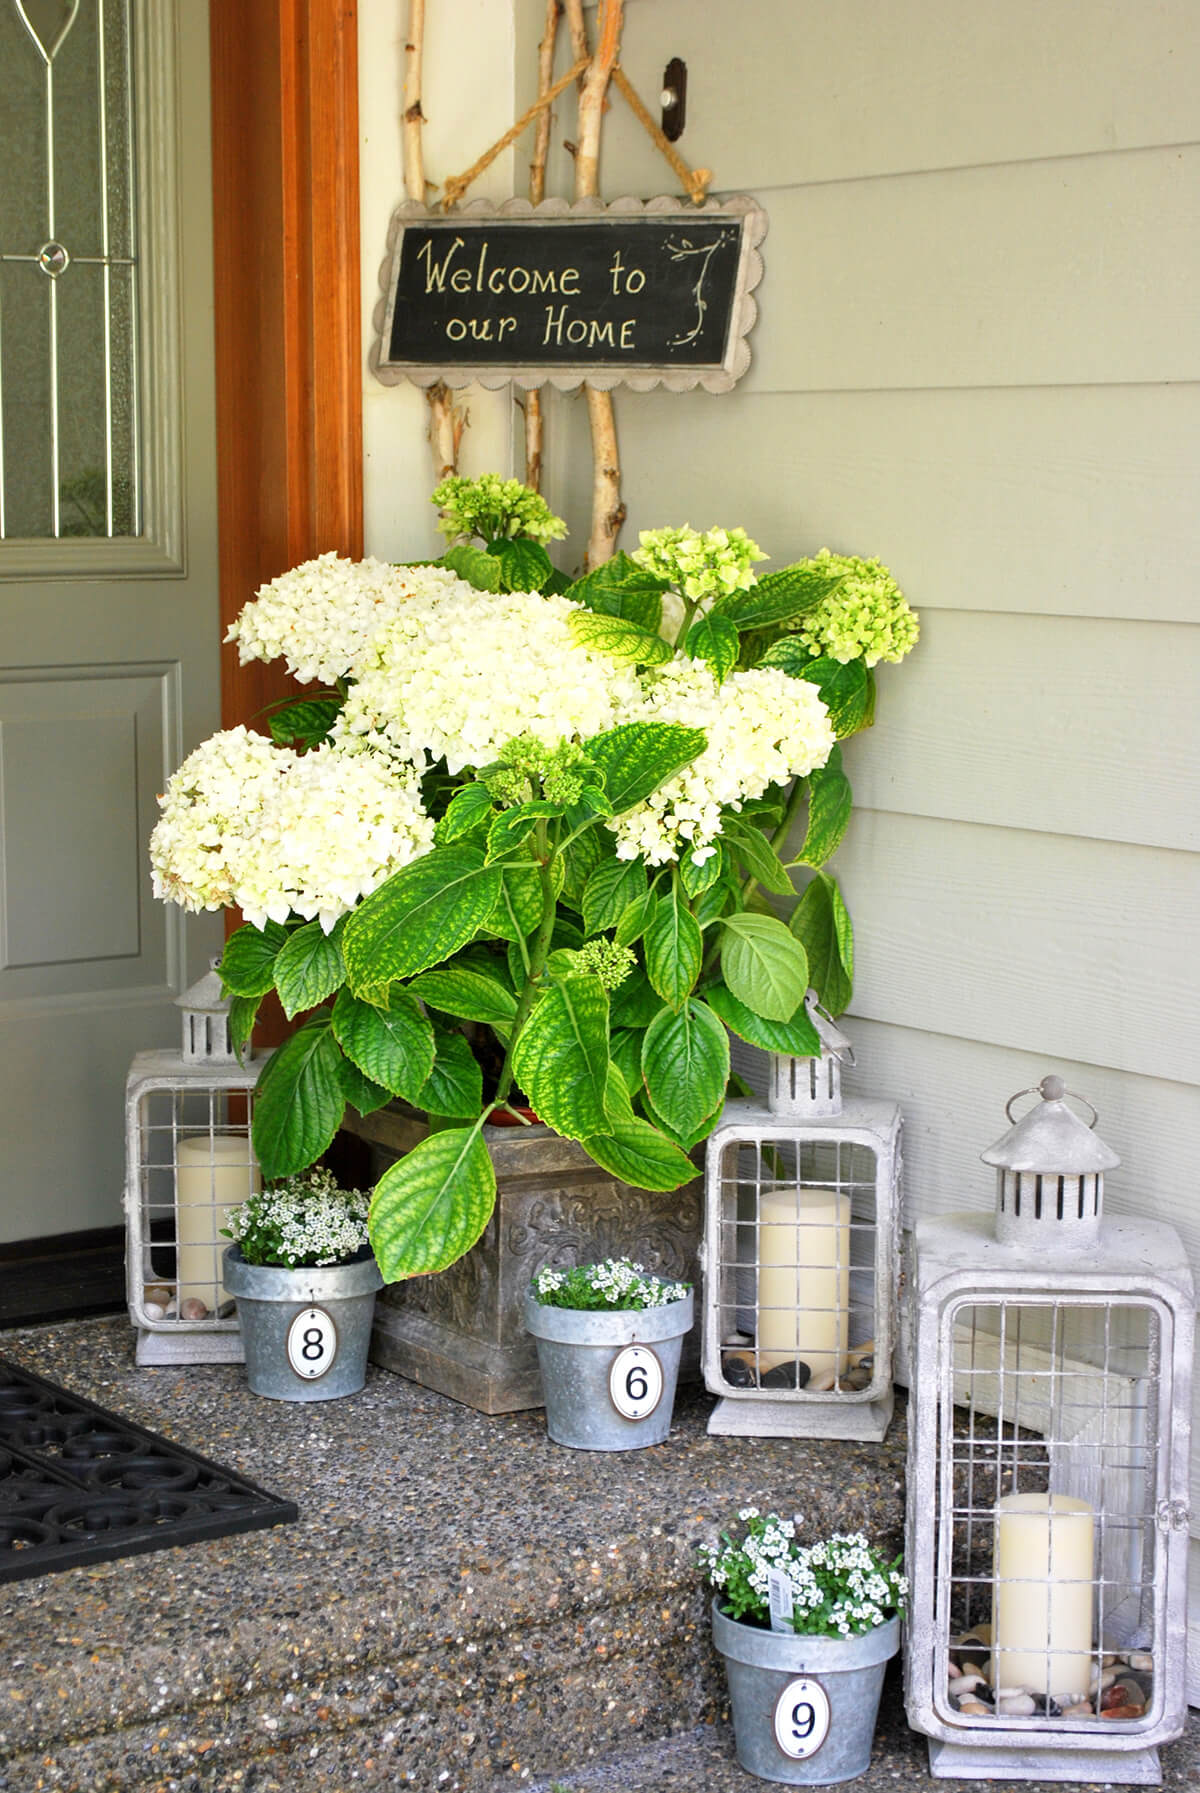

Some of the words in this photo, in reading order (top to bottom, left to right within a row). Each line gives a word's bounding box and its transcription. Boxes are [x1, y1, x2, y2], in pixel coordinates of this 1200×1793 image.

[417, 237, 581, 295] Welcome
[609, 250, 646, 295] to
[446, 316, 518, 343] our
[302, 1327, 324, 1361] 8
[625, 1366, 649, 1401] 6
[791, 1702, 816, 1739] 9
